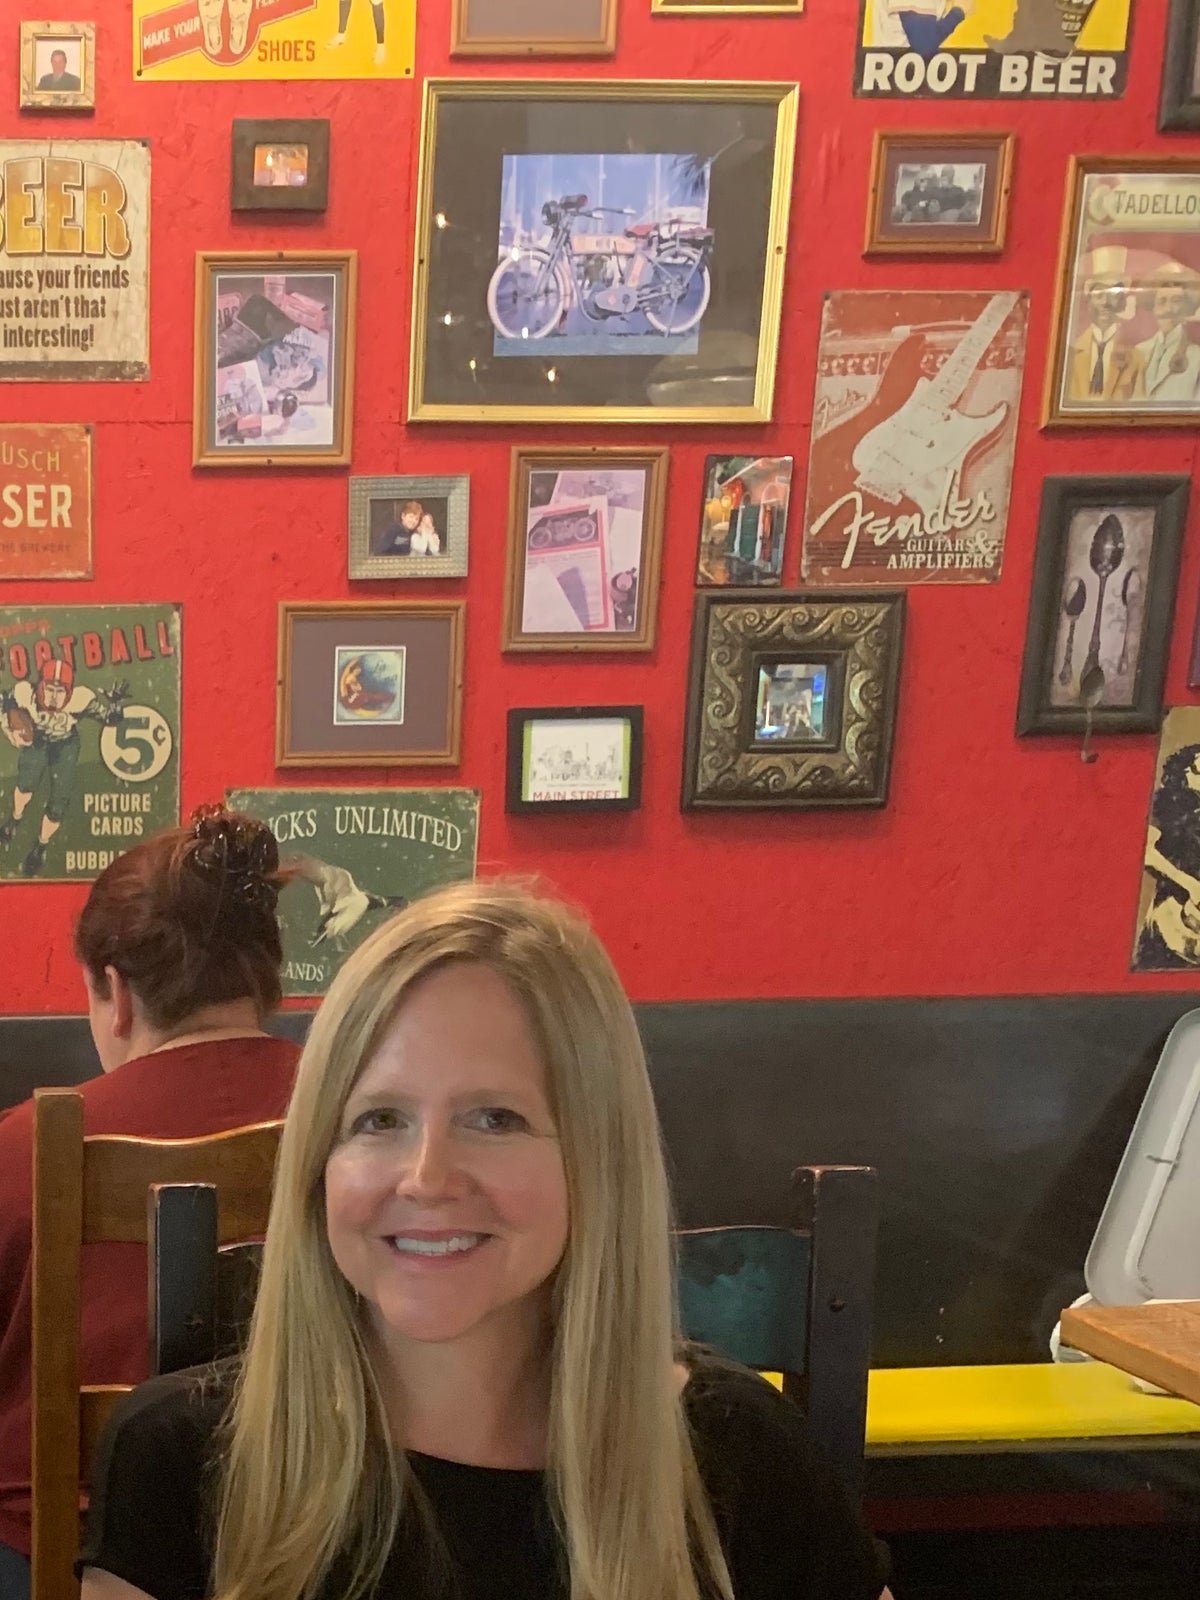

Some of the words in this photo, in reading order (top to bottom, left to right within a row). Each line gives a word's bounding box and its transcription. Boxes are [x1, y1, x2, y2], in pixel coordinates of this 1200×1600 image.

[144, 27, 170, 50] MAKE
[173, 16, 200, 38] YOUR
[258, 40, 315, 62] SHOES
[862, 52, 987, 93] ROOT
[1000, 54, 1117, 94] BEER
[37, 267, 71, 293] your
[74, 264, 130, 289] friends
[23, 295, 71, 318] aren't
[74, 295, 107, 319] that
[3, 324, 95, 352] interesting!
[809, 469, 997, 570] Fender
[906, 538, 974, 552] GUITARS
[887, 553, 994, 569] AMPLIFIERS
[84, 793, 151, 813] PICTURE
[533, 791, 567, 801] MAIN
[571, 790, 620, 800] STREET
[91, 817, 144, 836] CARDS
[335, 805, 462, 853] UNLIMITED
[280, 961, 325, 982] ANDS
